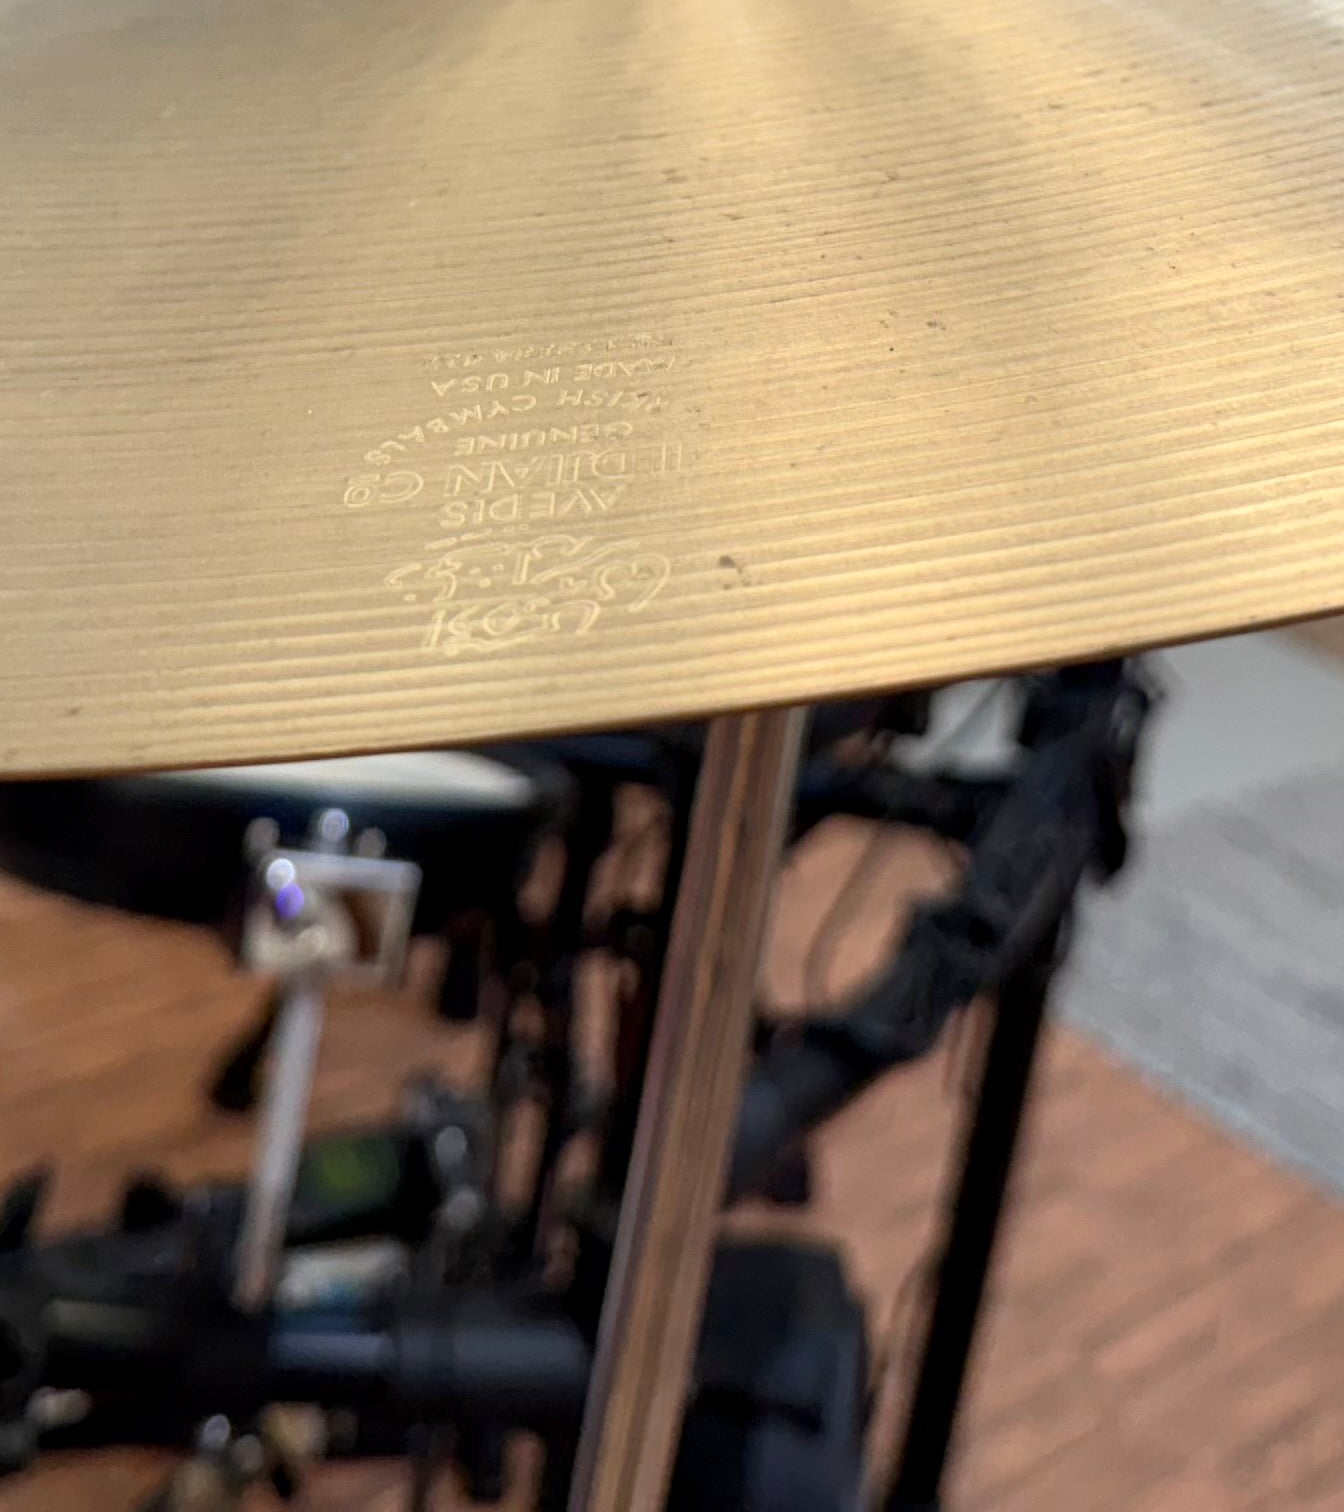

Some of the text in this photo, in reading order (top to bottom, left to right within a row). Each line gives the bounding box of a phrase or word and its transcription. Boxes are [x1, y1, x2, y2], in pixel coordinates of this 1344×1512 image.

[430, 355, 676, 397] MADE IN USA
[363, 394, 537, 467] CYMBALS
[454, 421, 634, 457] GENUINE
[443, 441, 683, 497] ILDJIAN
[439, 485, 626, 529] AVEDIS
